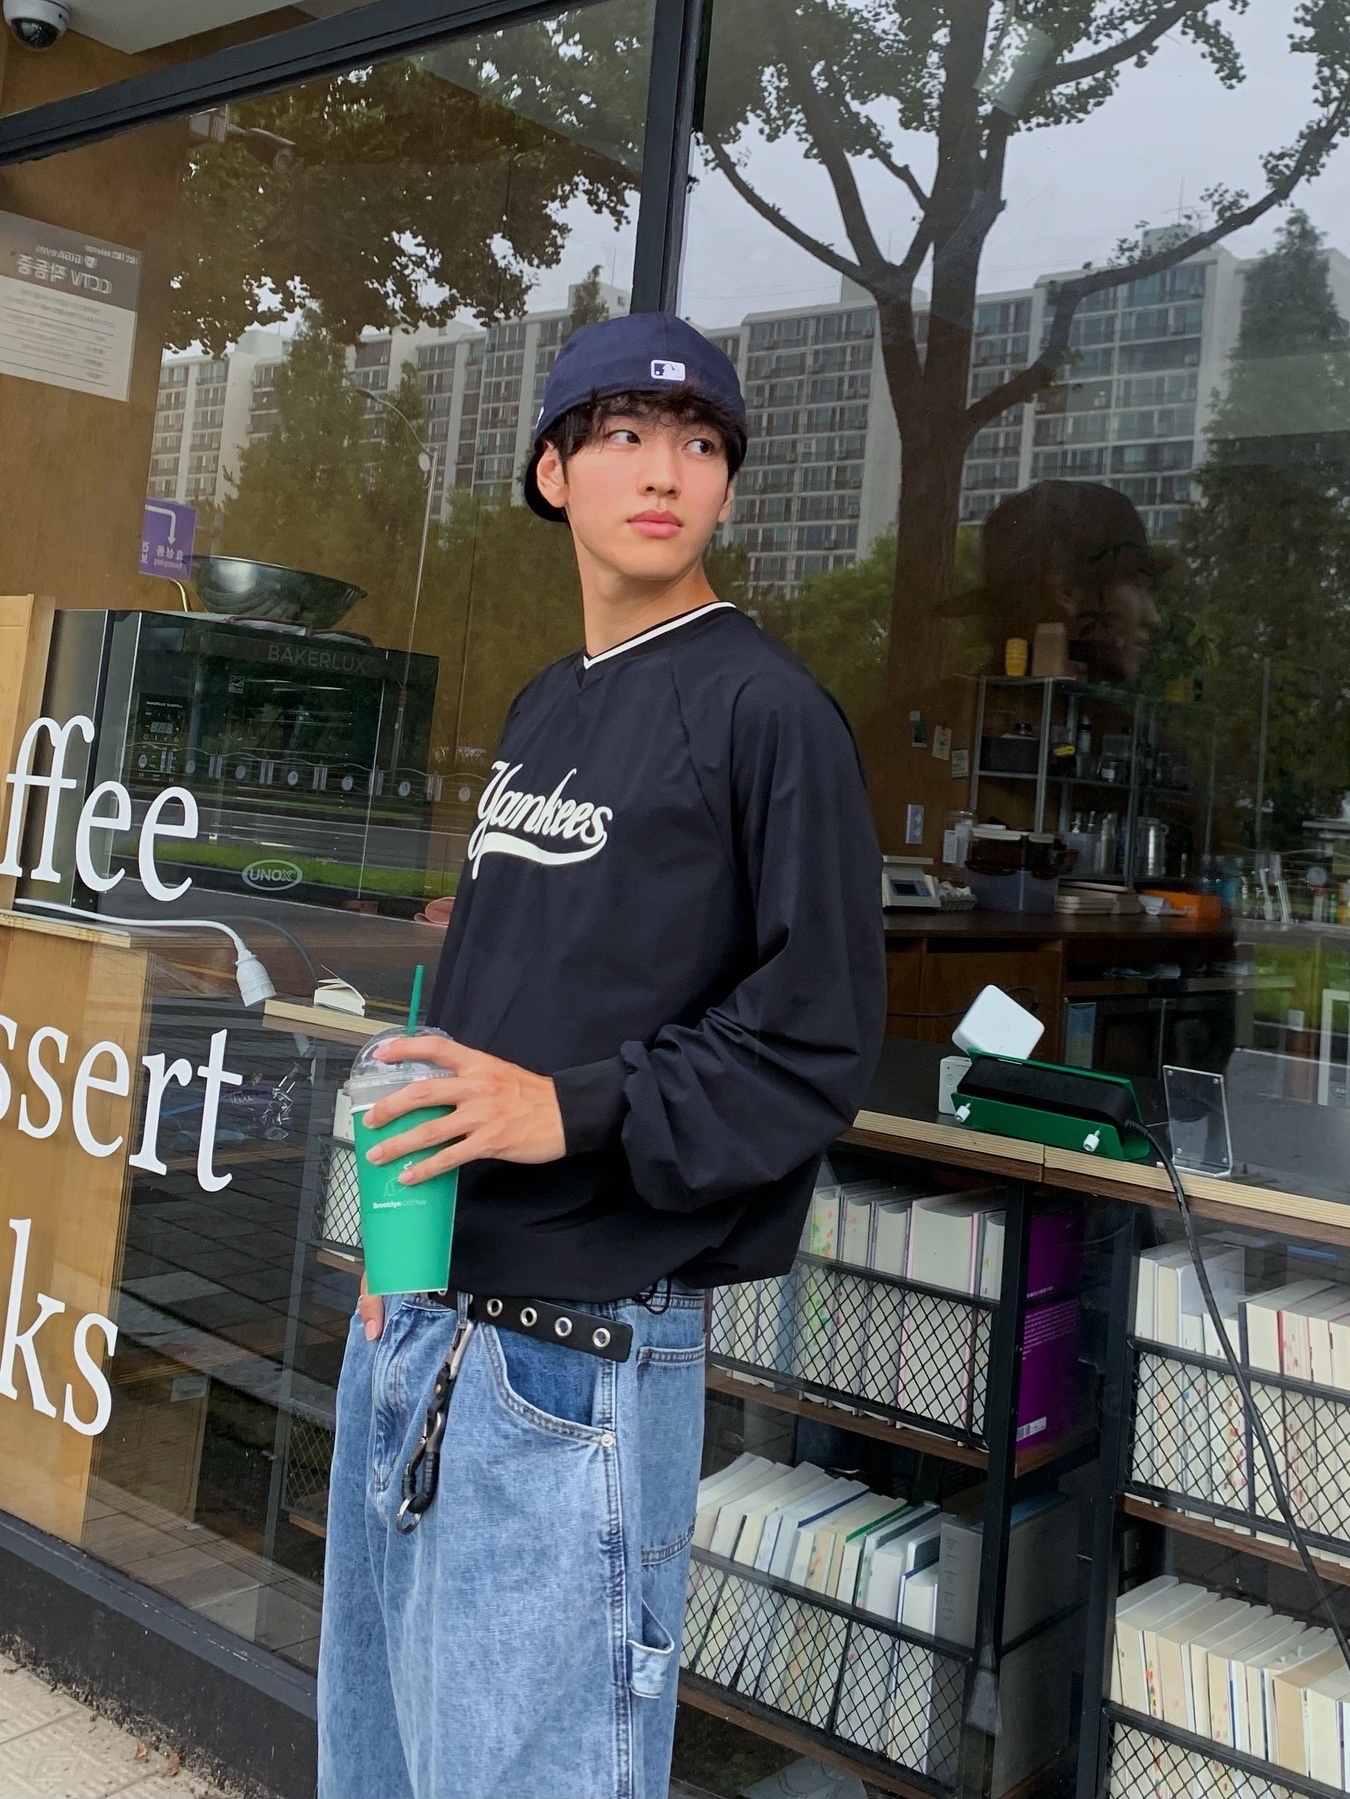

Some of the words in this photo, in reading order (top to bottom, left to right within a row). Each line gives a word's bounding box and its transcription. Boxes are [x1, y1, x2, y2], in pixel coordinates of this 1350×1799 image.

[267, 644, 368, 674] BAKERLUX
[0, 715, 199, 902] ffee
[468, 760, 613, 880] Yankees
[250, 866, 293, 883] UNOX
[373, 1200, 401, 1209] Brooklyn
[0, 1218, 118, 1436] ks
